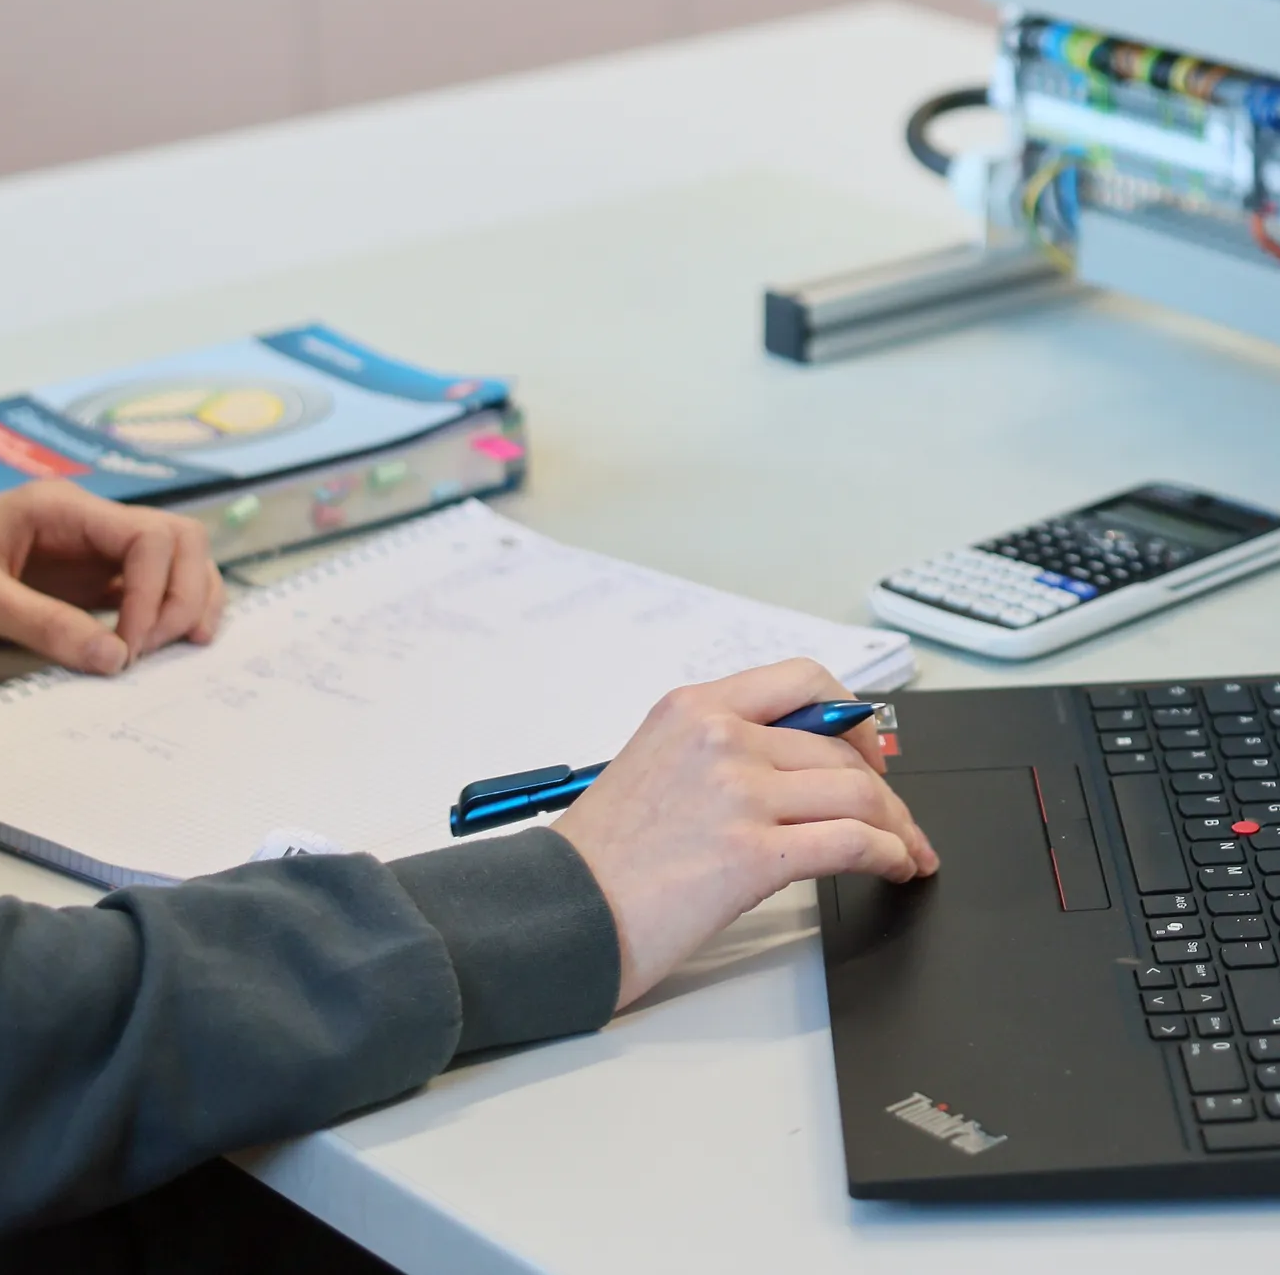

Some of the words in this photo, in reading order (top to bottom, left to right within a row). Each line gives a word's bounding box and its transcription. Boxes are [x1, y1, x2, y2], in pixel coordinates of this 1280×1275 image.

[1220, 842, 1235, 850] N
[1227, 866, 1243, 875] M
[1187, 941, 1199, 953] Strg
[1212, 1042, 1231, 1050] 0
[885, 1091, 1008, 1154] ThinkPad
